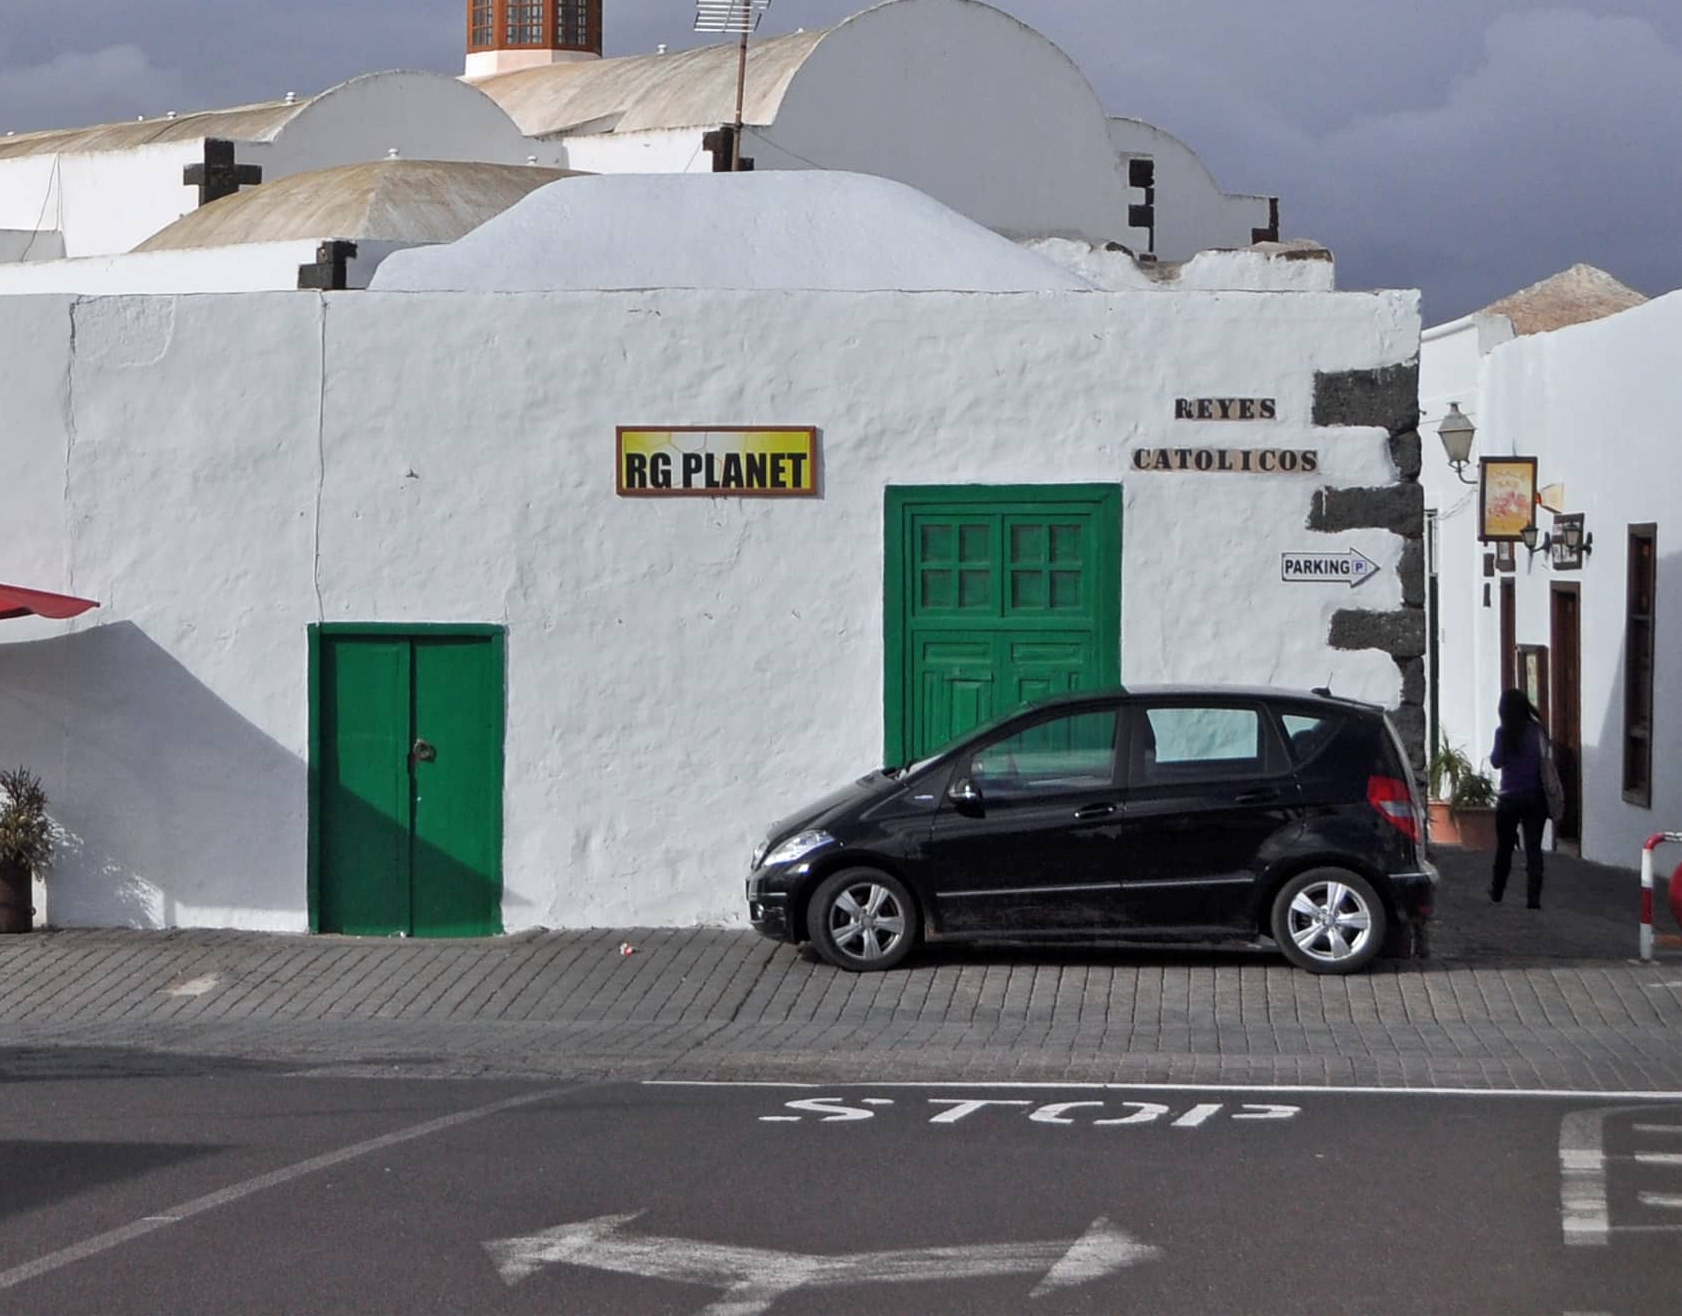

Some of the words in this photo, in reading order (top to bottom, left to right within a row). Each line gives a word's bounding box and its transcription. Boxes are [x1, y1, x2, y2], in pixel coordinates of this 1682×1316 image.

[1174, 398, 1276, 419] REYES
[625, 452, 672, 489] RG
[682, 452, 808, 489] PLANET
[1132, 447, 1318, 471] CATOLICOS
[1285, 559, 1350, 575] PARKING
[757, 1097, 1302, 1128] STOP
